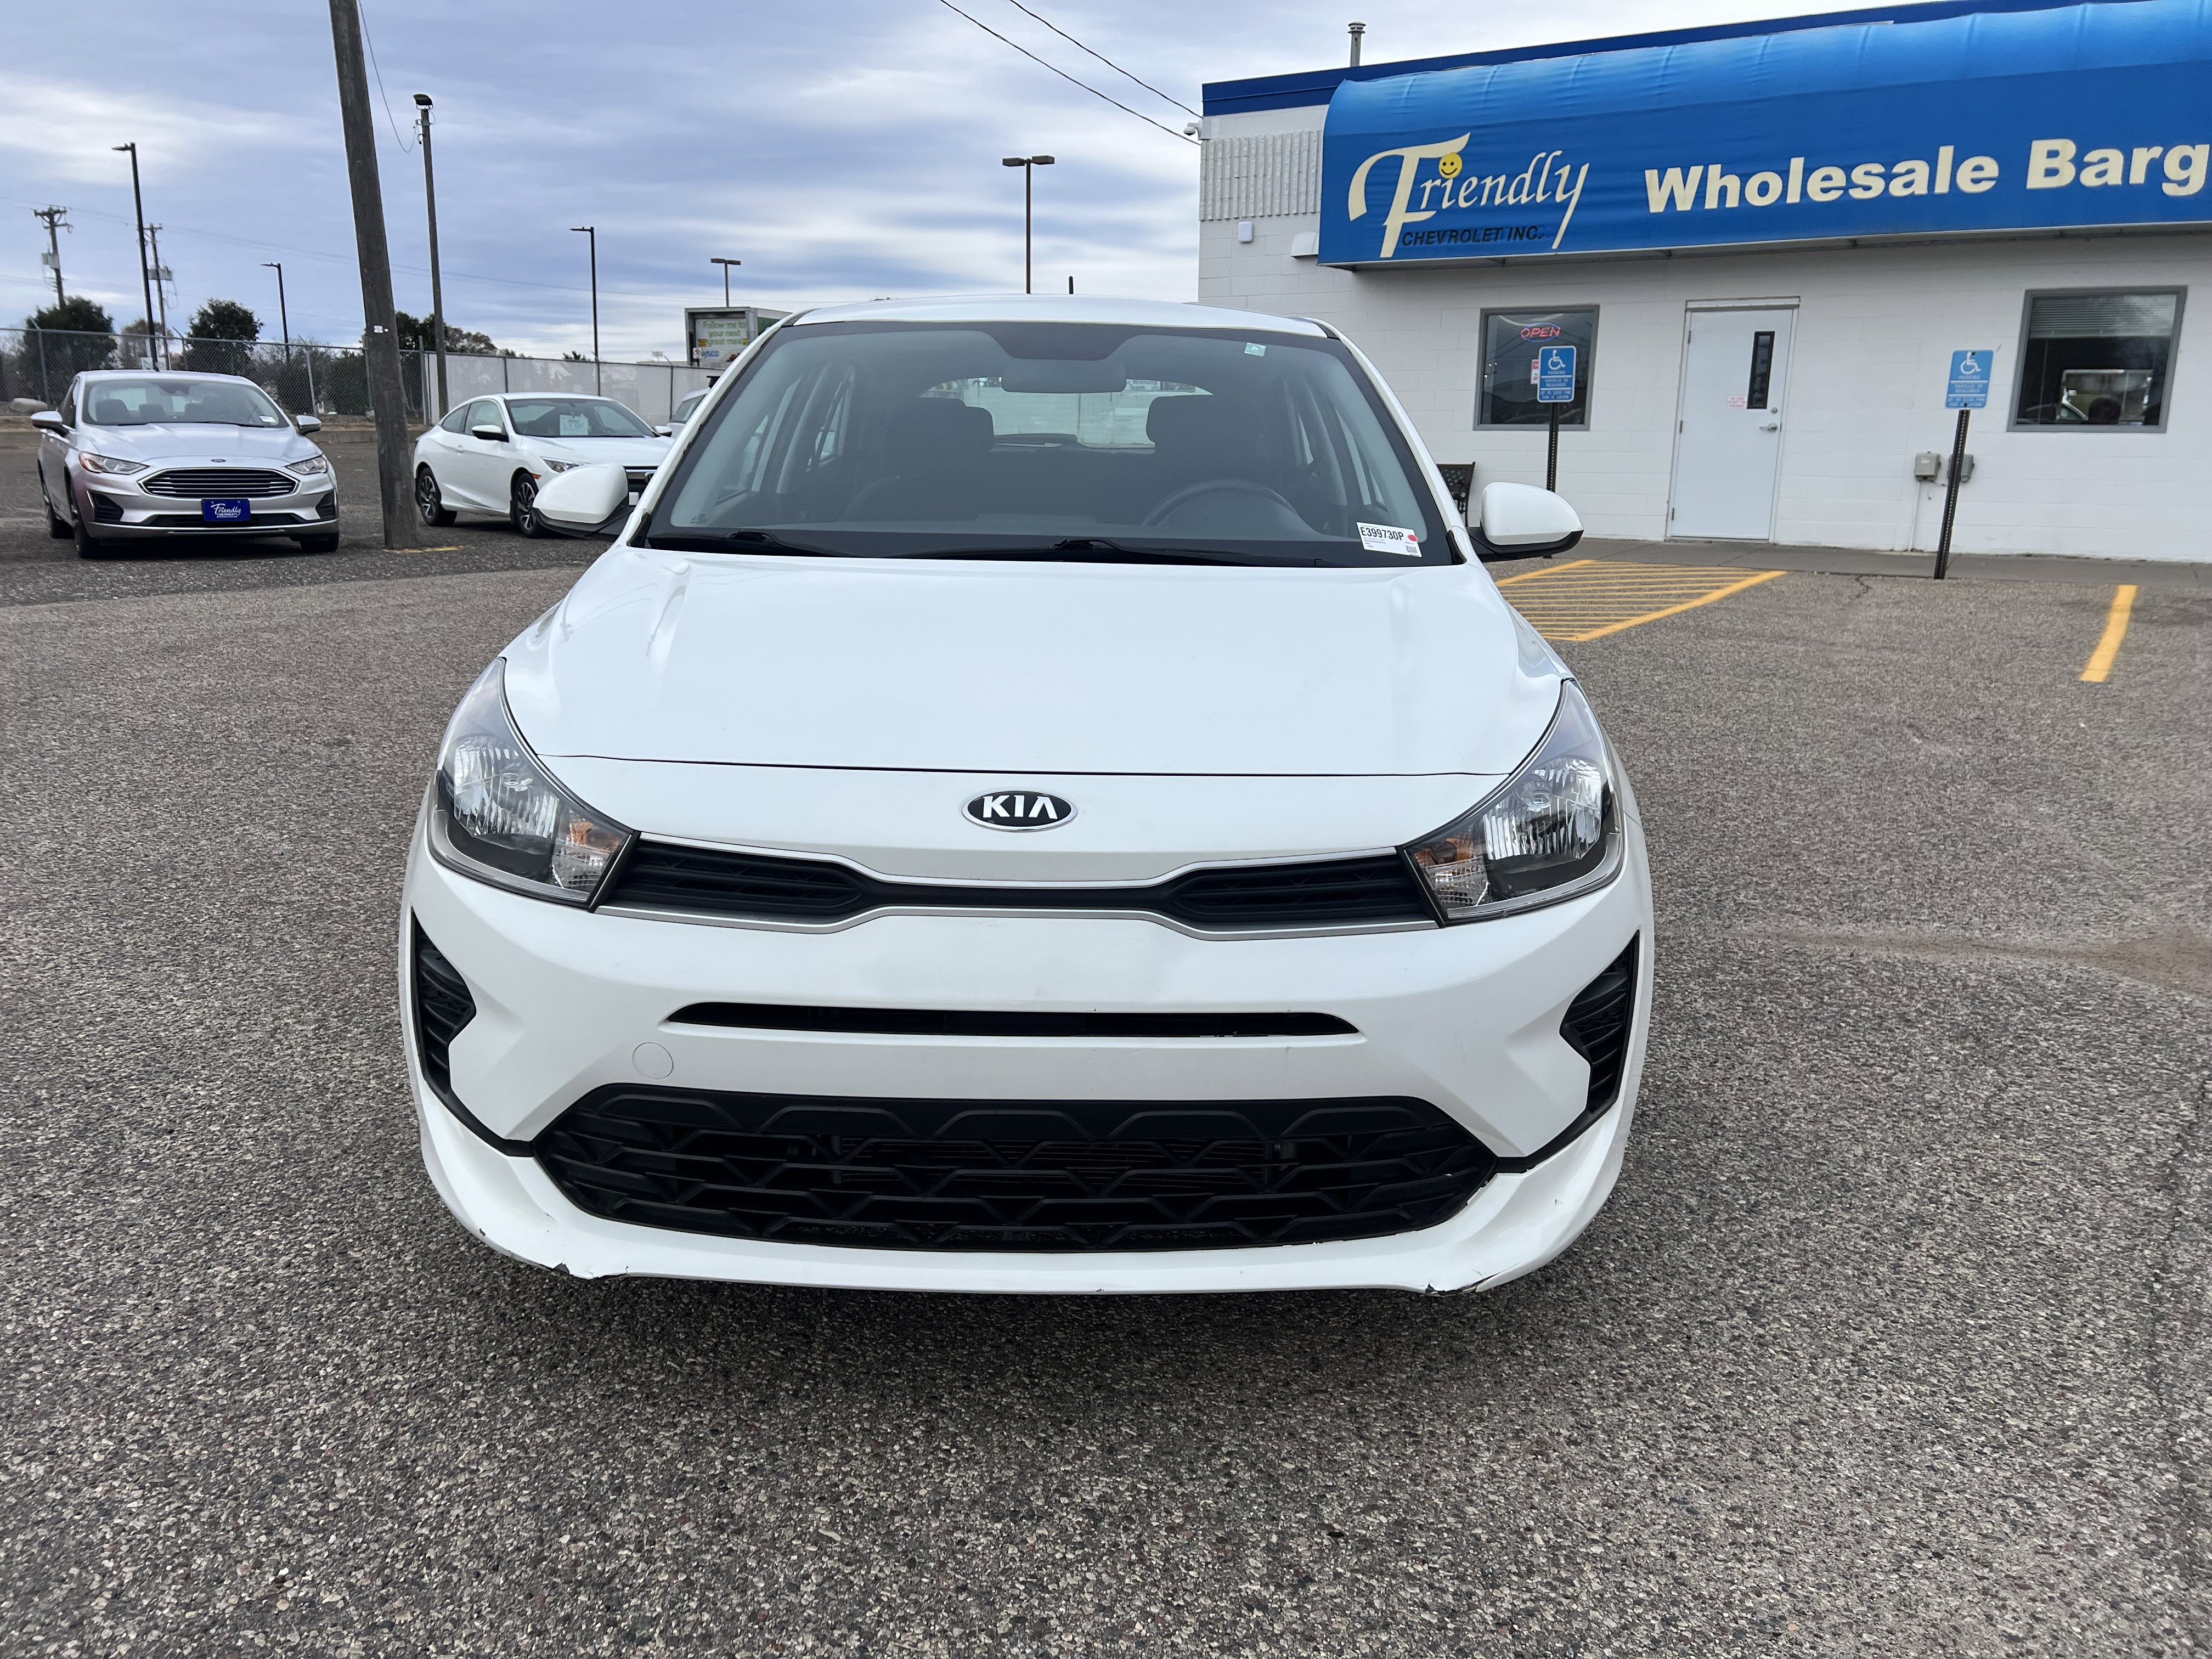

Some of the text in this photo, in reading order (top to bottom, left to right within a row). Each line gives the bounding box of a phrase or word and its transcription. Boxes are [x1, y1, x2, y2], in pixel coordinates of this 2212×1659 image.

[1645, 138, 2210, 213] Wholesale Barg
[1348, 132, 1589, 257] Friendly
[1402, 225, 1543, 246] CHEVROLET INC.
[1520, 326, 1562, 338] OPEN
[211, 503, 241, 516] Friendly
[1360, 527, 1404, 540] E399730P
[983, 795, 1058, 820] KIA
